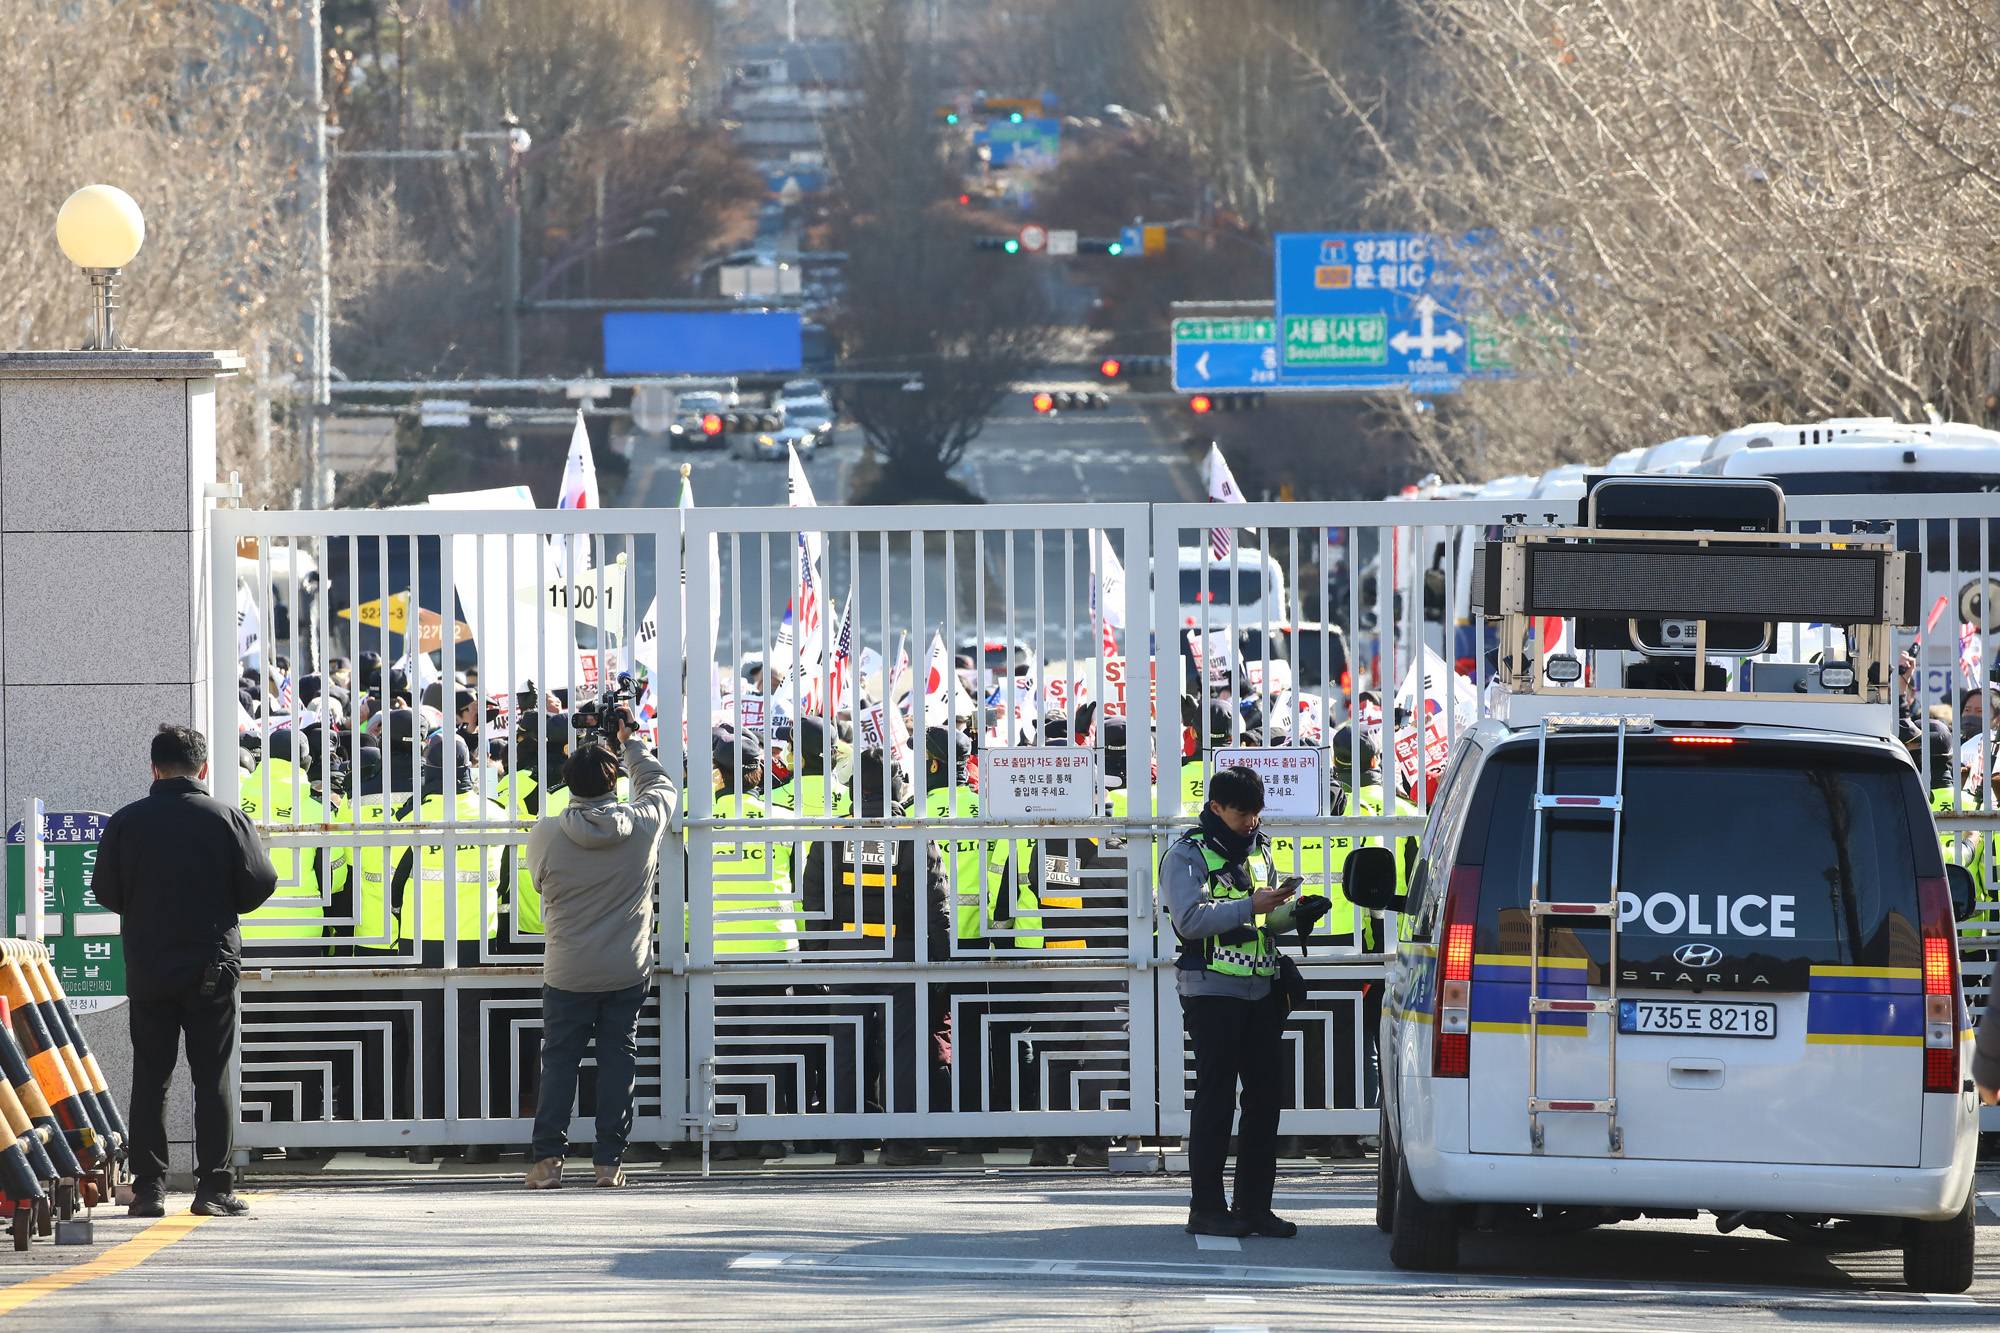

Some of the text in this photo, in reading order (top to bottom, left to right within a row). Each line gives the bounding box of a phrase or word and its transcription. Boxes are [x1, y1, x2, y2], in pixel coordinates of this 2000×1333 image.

[1288, 319, 1384, 343] 서울(사당)
[993, 757, 1088, 768] 도보 출입자 차도 출입 금지
[1220, 758, 1315, 768] 도보 출입자 차도 출입 금지
[1010, 774, 1072, 784] 우측 인도를 통해
[1260, 775, 1298, 784] 도를 통해
[1014, 787, 1068, 797] 출입해 주세요.
[1268, 787, 1295, 797] 주세요.
[15, 828, 104, 842] 승차요일제
[1616, 892, 1795, 937] POLICE
[84, 943, 111, 959] 번
[1623, 971, 1769, 984] STARIA
[70, 1000, 97, 1010] 천청사
[1639, 1006, 1768, 1031] 735도 8218
